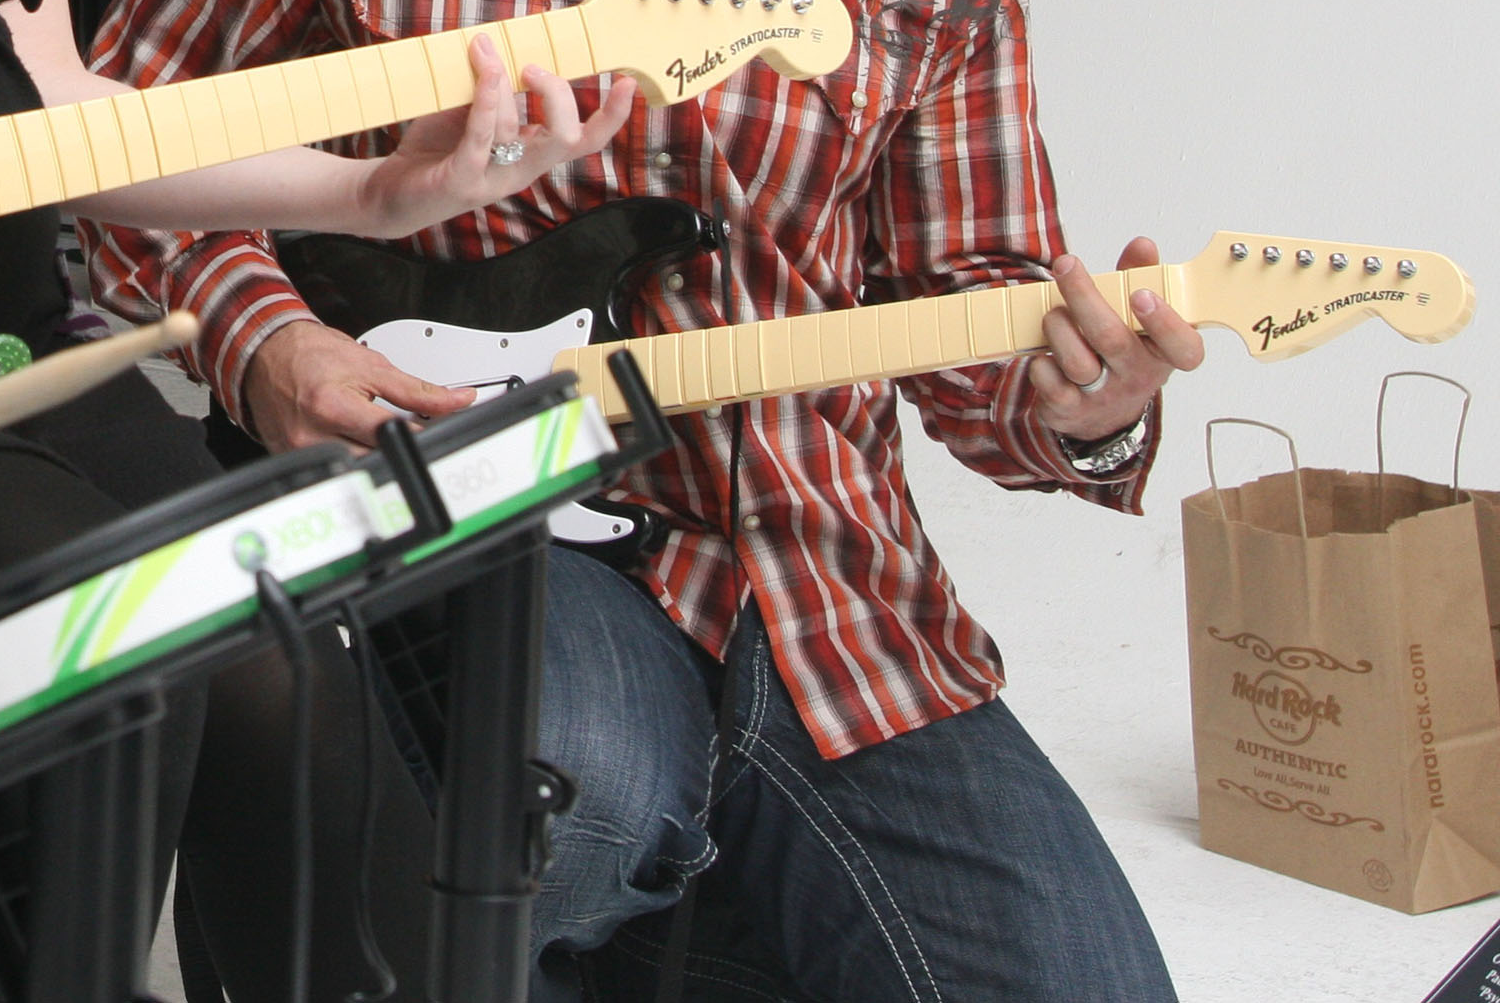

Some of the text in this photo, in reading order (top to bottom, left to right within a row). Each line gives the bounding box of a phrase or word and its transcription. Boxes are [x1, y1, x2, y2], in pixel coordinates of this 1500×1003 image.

[666, 27, 802, 96] Fender STRATOCASTER
[1251, 308, 1319, 351] Fender
[1324, 291, 1404, 315] STRATOCASTER
[444, 456, 499, 502] 360
[1231, 671, 1342, 727] Hard Rock
[1235, 739, 1348, 779] AUTHENTIC
